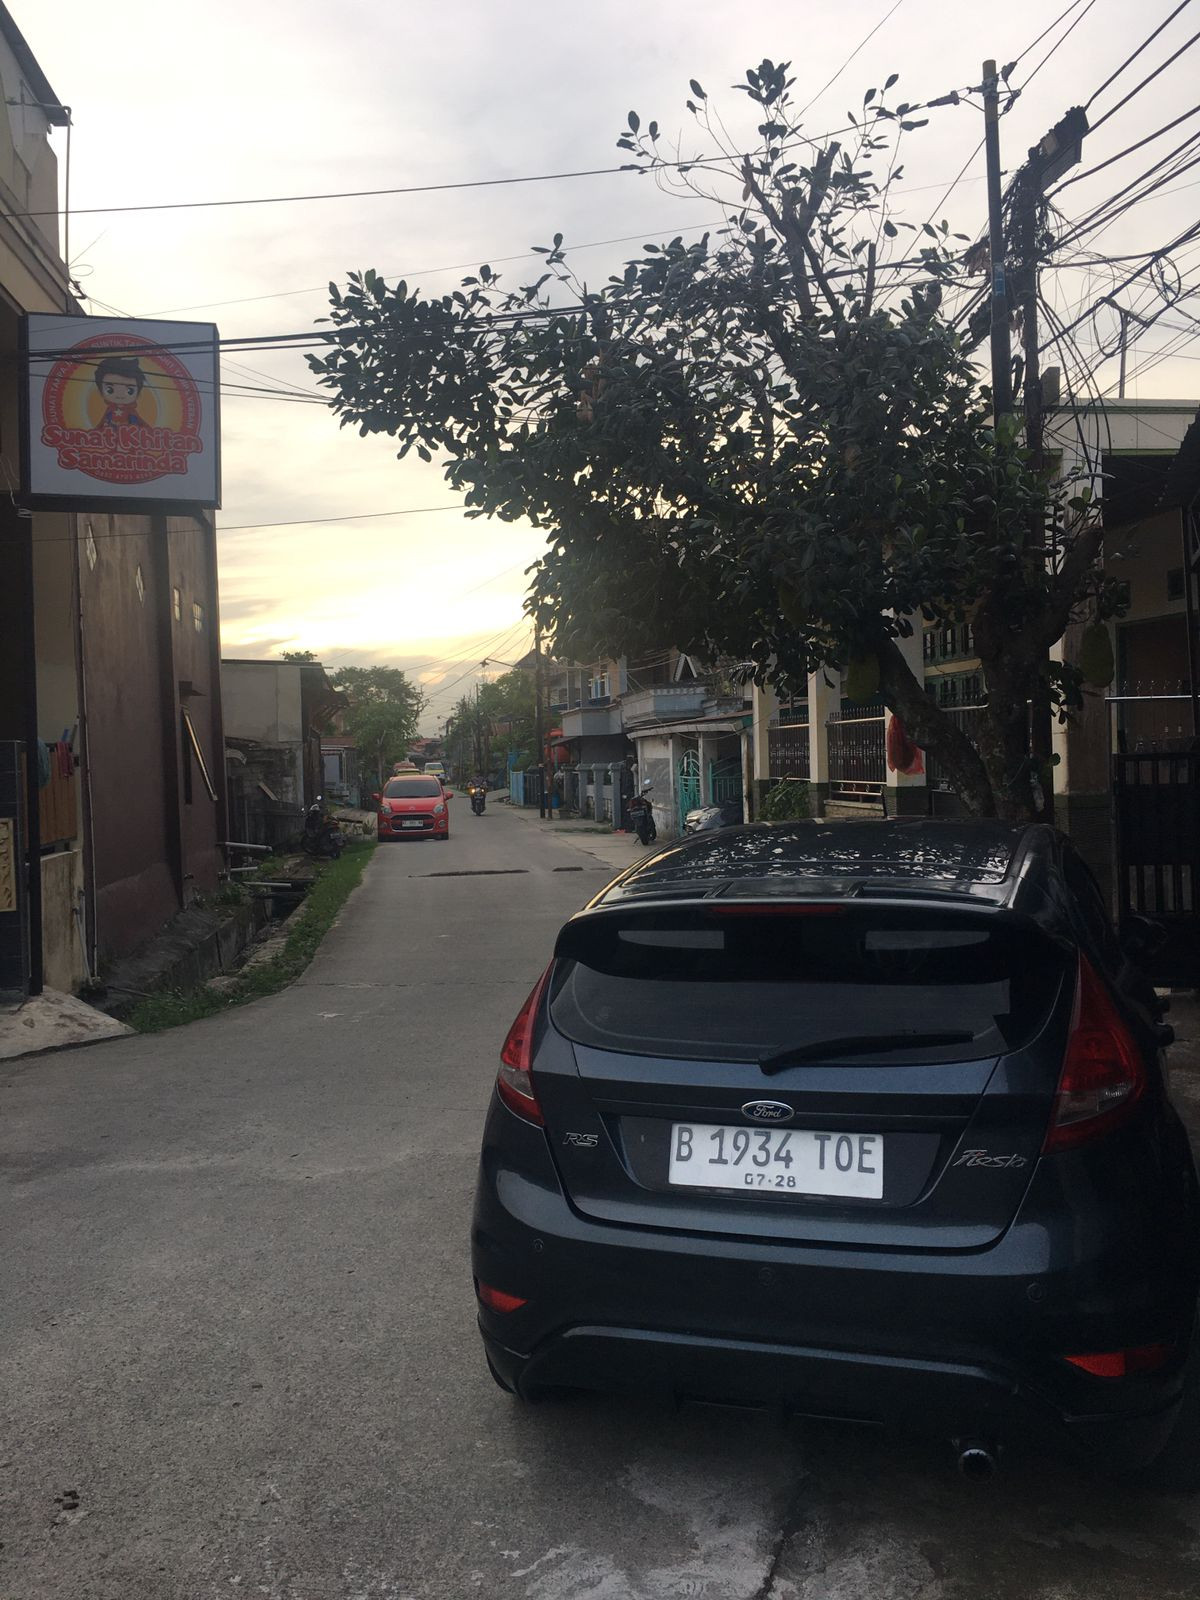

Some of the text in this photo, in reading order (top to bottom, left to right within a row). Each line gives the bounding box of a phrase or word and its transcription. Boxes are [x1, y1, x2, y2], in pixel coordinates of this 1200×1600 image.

[43, 425, 202, 452] Sunat Khitan
[59, 447, 187, 474] Samarinda
[752, 1104, 783, 1119] Ford
[562, 1132, 600, 1148] RS
[675, 1126, 876, 1174] B 1934 TOE
[953, 1149, 1027, 1169] Fiesta
